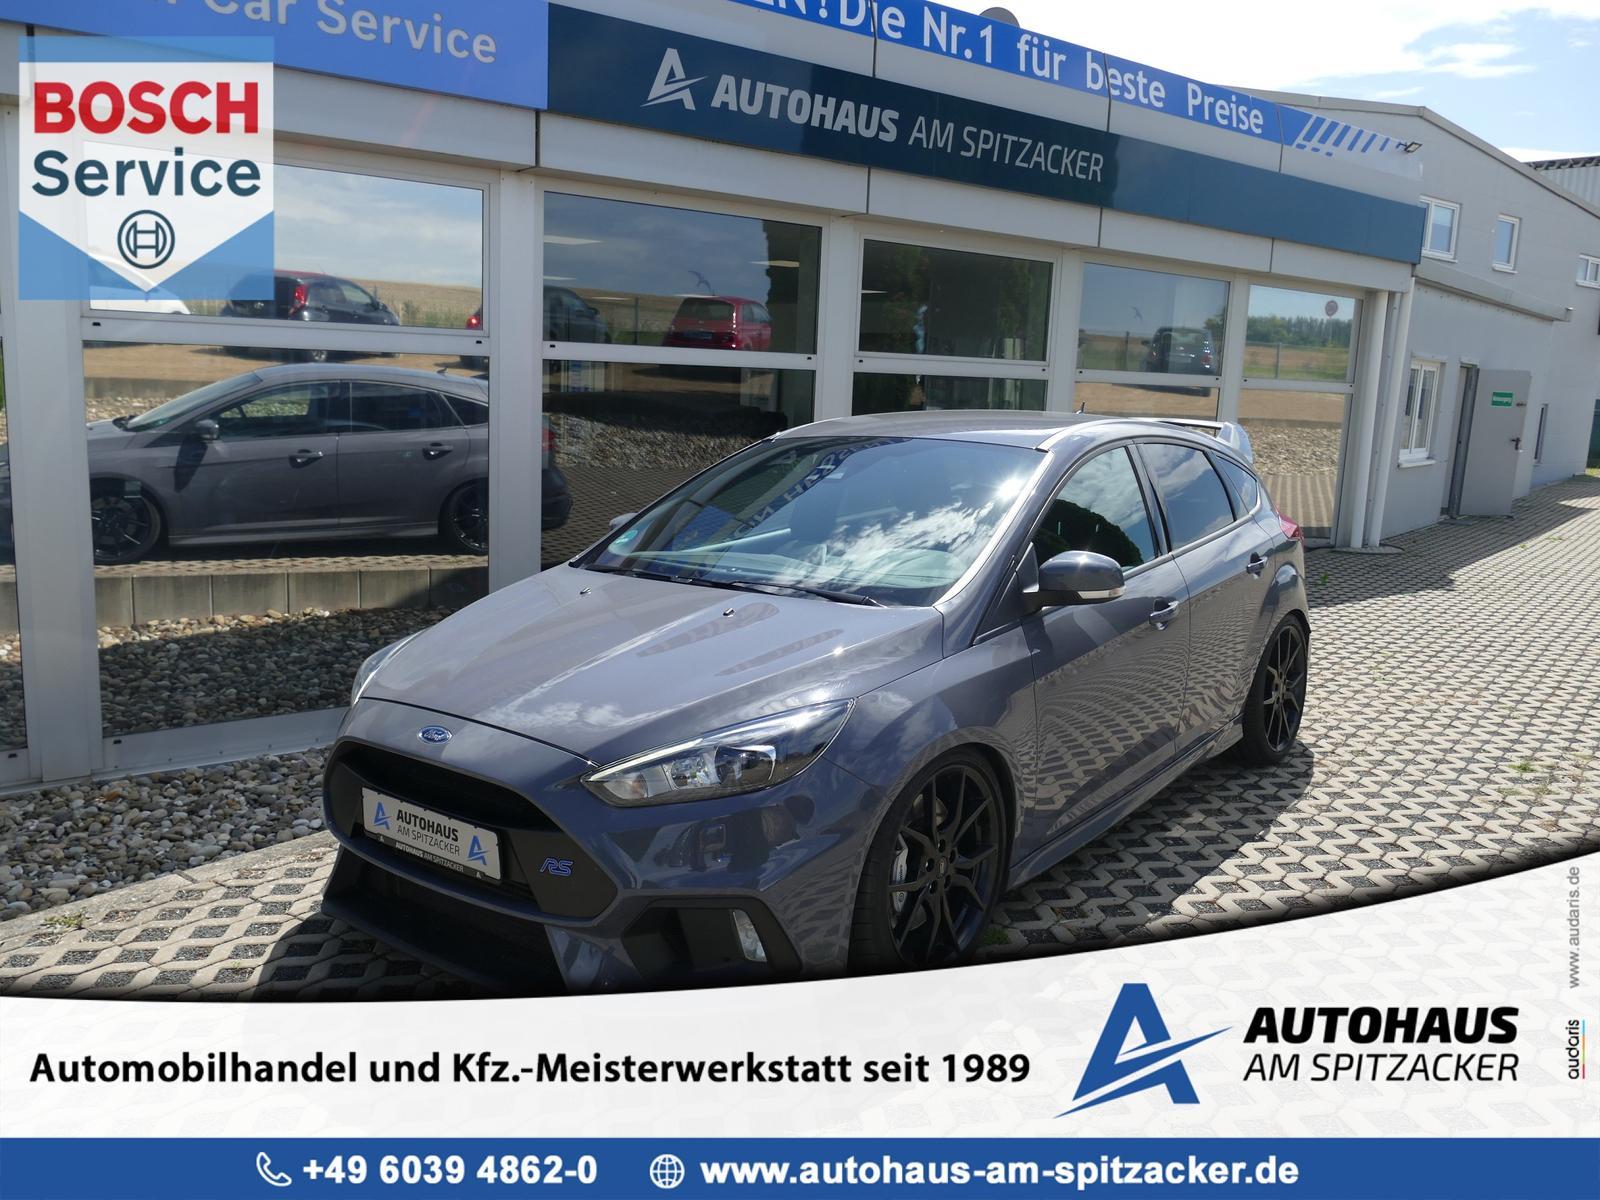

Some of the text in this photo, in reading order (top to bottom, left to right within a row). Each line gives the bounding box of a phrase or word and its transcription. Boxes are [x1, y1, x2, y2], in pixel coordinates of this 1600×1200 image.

[317, 0, 498, 64] Service
[923, 10, 993, 63] Nr.1
[1017, 34, 1067, 81] für
[1086, 50, 1167, 109] beste
[1187, 81, 1264, 135] Preise
[710, 74, 1104, 183] AUTOHAUS AM SPITZACKER
[396, 809, 460, 843] AUTOHAUS
[397, 824, 461, 857] AM SPITZACKER
[540, 857, 574, 877] RS
